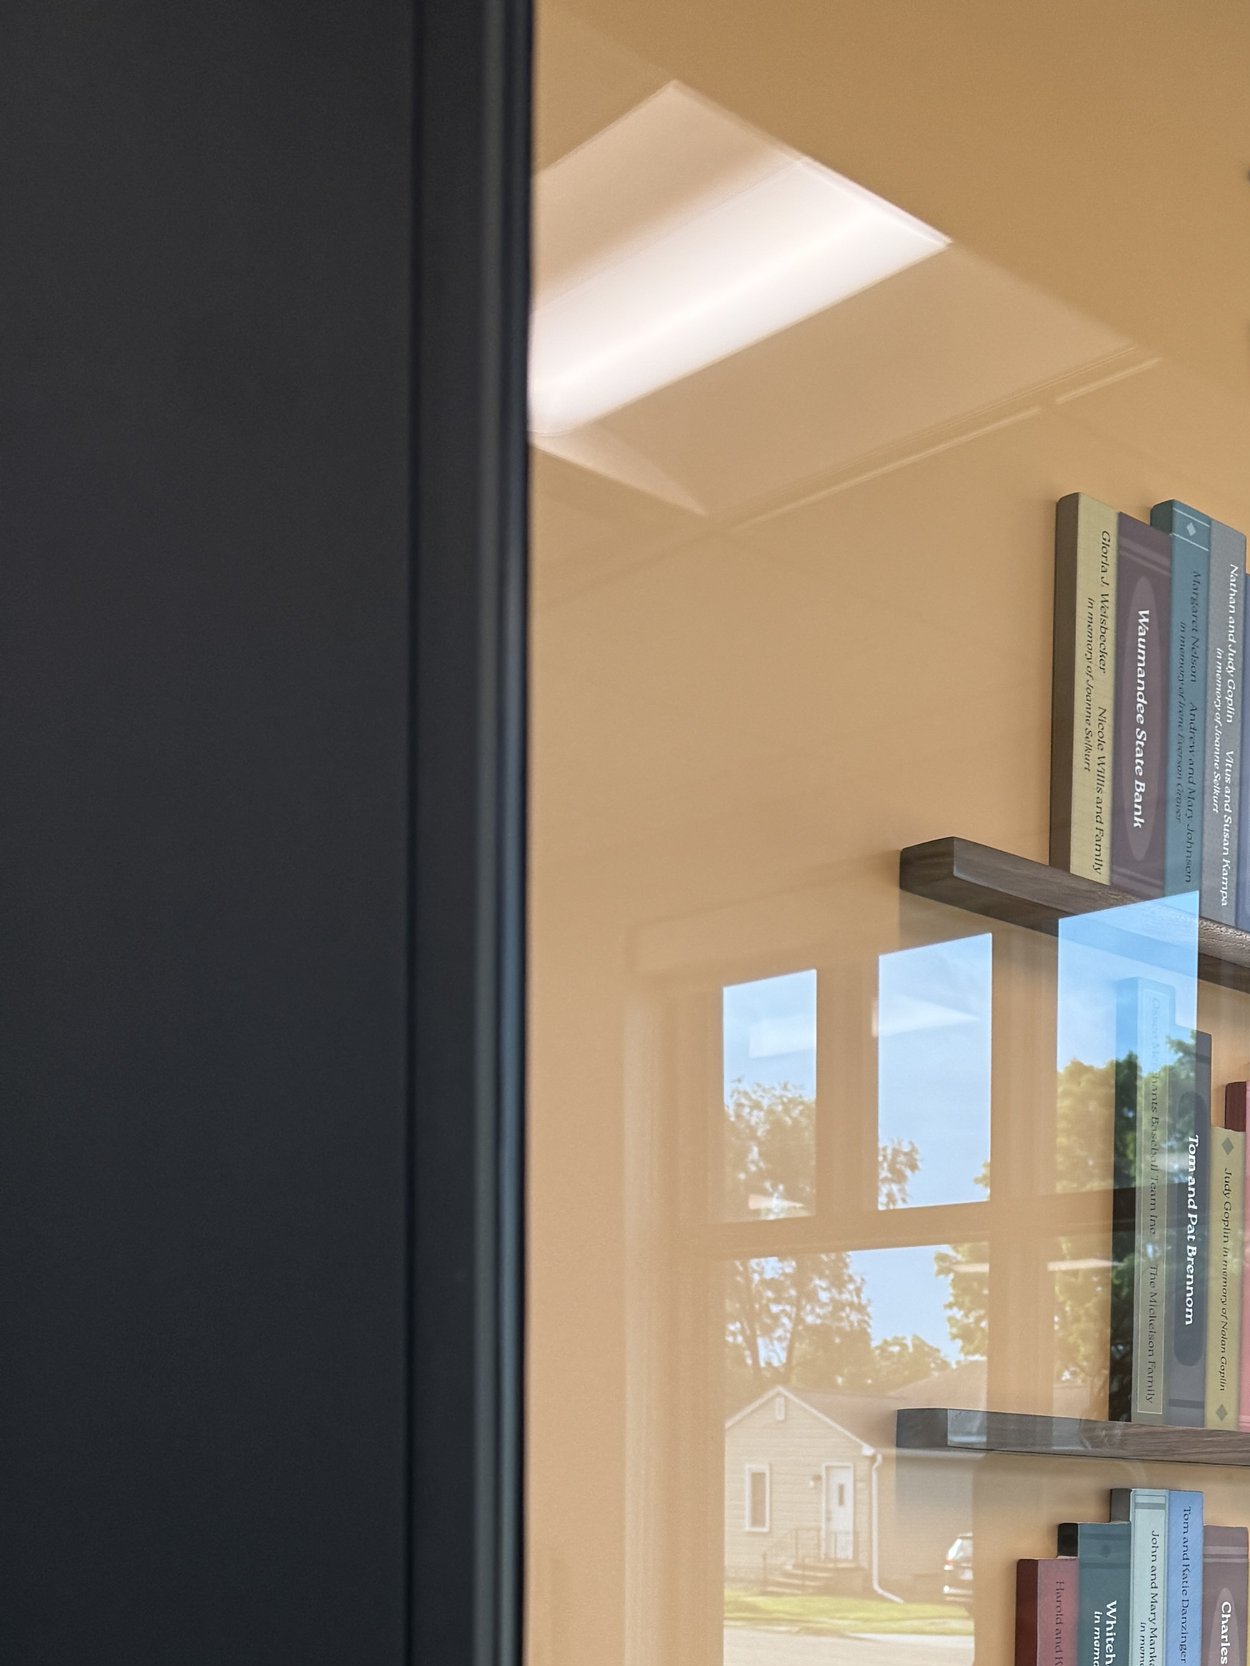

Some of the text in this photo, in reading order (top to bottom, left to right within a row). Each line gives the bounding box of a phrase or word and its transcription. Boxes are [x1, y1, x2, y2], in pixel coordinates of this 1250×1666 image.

[1132, 609, 1149, 828] Waumandee State Bank
[1219, 750, 1234, 906] Vitus and Susan Kampa
[1219, 1601, 1231, 1664] Charles
